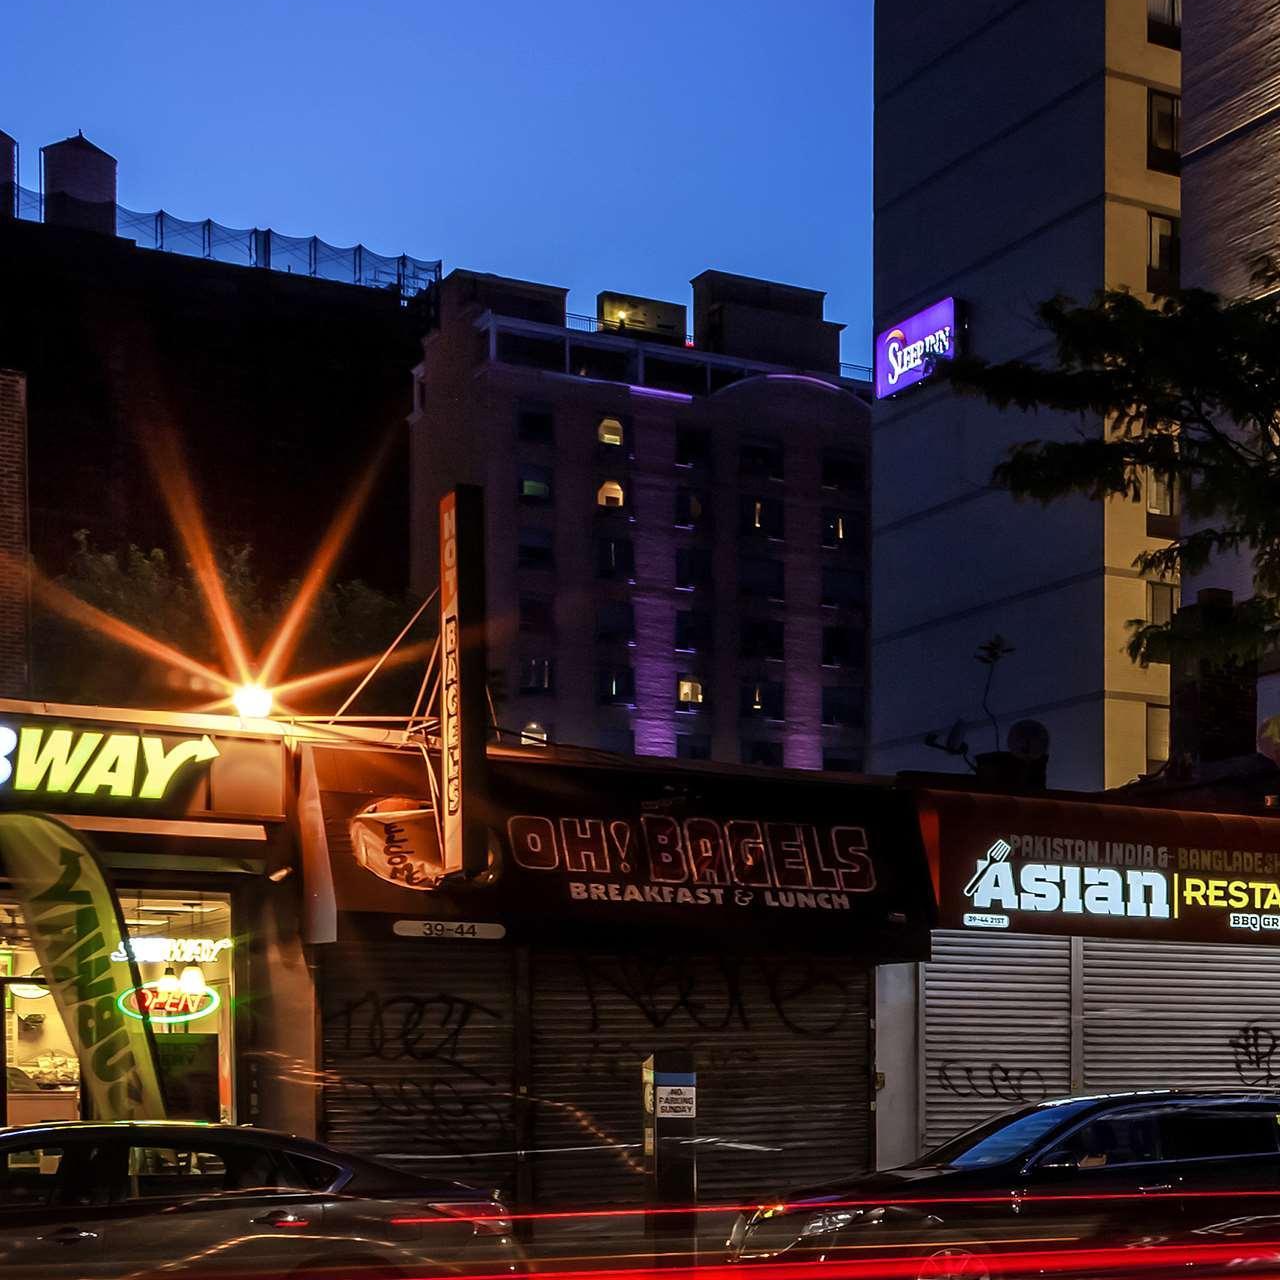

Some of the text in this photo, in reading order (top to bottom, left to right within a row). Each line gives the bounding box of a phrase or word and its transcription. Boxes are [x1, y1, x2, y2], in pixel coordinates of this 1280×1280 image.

[443, 511, 457, 593] HOT
[445, 615, 461, 816] BAGELS
[506, 814, 632, 874] OH!
[639, 813, 878, 893] BAGELS
[568, 881, 851, 910] BREAKFAST & LUNCH
[423, 923, 477, 937] 39-44
[1230, 913, 1260, 931] BBQ
[111, 937, 234, 962] SWAY
[131, 987, 203, 1013] OPEN
